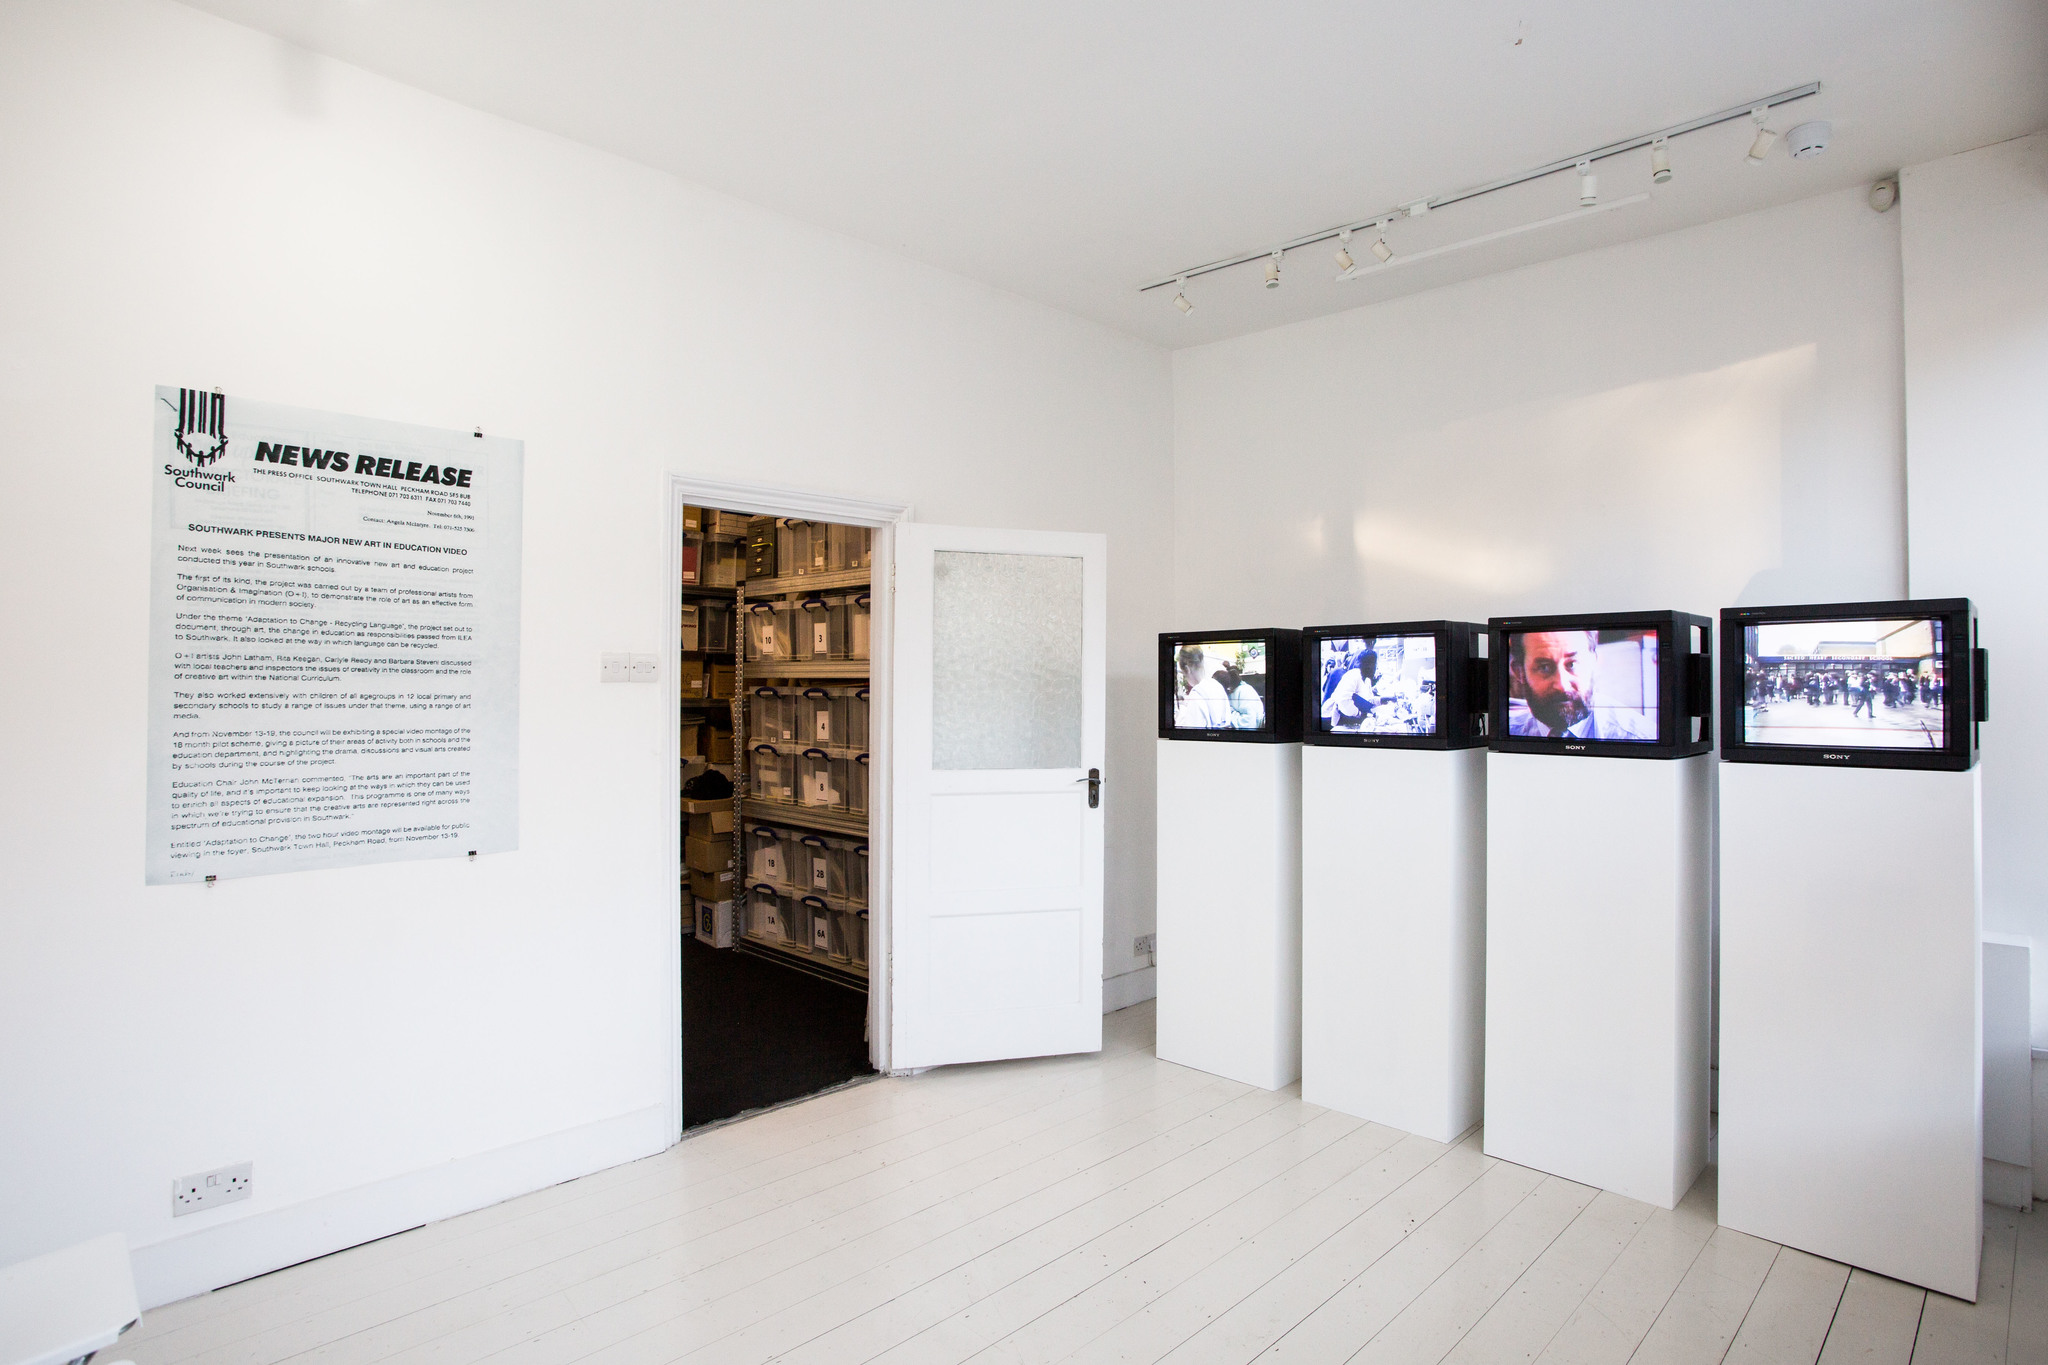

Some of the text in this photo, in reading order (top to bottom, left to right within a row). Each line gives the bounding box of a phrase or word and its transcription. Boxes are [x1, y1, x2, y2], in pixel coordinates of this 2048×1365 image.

[255, 441, 473, 488] NEWS RELEASE
[164, 464, 236, 483] Southwark
[175, 476, 224, 492] Council
[267, 469, 287, 477] PRESS
[288, 472, 313, 480] OFFICE
[316, 475, 359, 486] SOUTHWARK
[360, 480, 381, 488] TOWN
[400, 485, 430, 494] PECKHAM
[430, 488, 448, 496] ROAD
[352, 487, 387, 497] TELEPHONE
[427, 509, 452, 519] November
[188, 524, 468, 555] SOUTHWARK PRESENTS MAJOR NEW ART IN EDUCATION VIDEO
[177, 555, 221, 565] conducted
[222, 558, 236, 566] this
[238, 561, 255, 569] year
[266, 561, 305, 571] Southwark
[307, 564, 336, 573] schools.
[178, 544, 197, 553] Next
[200, 546, 222, 555] week
[248, 550, 260, 558] the
[264, 551, 310, 563] presentation
[336, 557, 370, 566] innovative
[391, 561, 400, 569] art
[403, 562, 416, 570] and
[418, 563, 450, 572] education
[452, 566, 474, 576] project
[177, 573, 193, 581] The
[195, 574, 210, 582] first
[222, 576, 232, 584] its
[234, 577, 252, 587] kind,
[255, 578, 267, 586] the
[269, 579, 295, 589] project
[314, 582, 339, 590] carried
[340, 583, 352, 591] out
[354, 584, 362, 594] by
[370, 585, 388, 594] team
[398, 587, 437, 598] professional
[438, 590, 457, 598] artists
[459, 591, 473, 599] from
[176, 594, 318, 610] of communication in modern society.
[176, 612, 201, 620] Under
[218, 614, 243, 622] theme
[245, 616, 288, 626] 'Adaptation
[299, 618, 328, 628] Change
[334, 620, 368, 630] Recycling
[369, 621, 406, 632] Language',
[408, 623, 418, 631] the
[420, 624, 442, 633] project
[454, 625, 465, 633] out
[175, 623, 218, 633] document,
[221, 625, 251, 635] through
[254, 626, 266, 635] art,
[283, 627, 310, 637] change
[312, 628, 319, 636] in
[320, 629, 355, 637] education
[367, 630, 415, 641] responsibilities
[416, 632, 440, 642] passed
[441, 633, 456, 641] from
[765, 636, 771, 644] 10
[819, 634, 822, 642] 3
[174, 692, 194, 700] They
[248, 692, 289, 701] extensively
[310, 692, 338, 700] children
[340, 692, 347, 700] of
[349, 692, 357, 700] all
[434, 693, 457, 702] primary
[820, 783, 824, 791] 8
[768, 859, 775, 867] 1B
[816, 870, 824, 878] 2B
[767, 916, 775, 925] 1A
[817, 930, 825, 938] 6A
